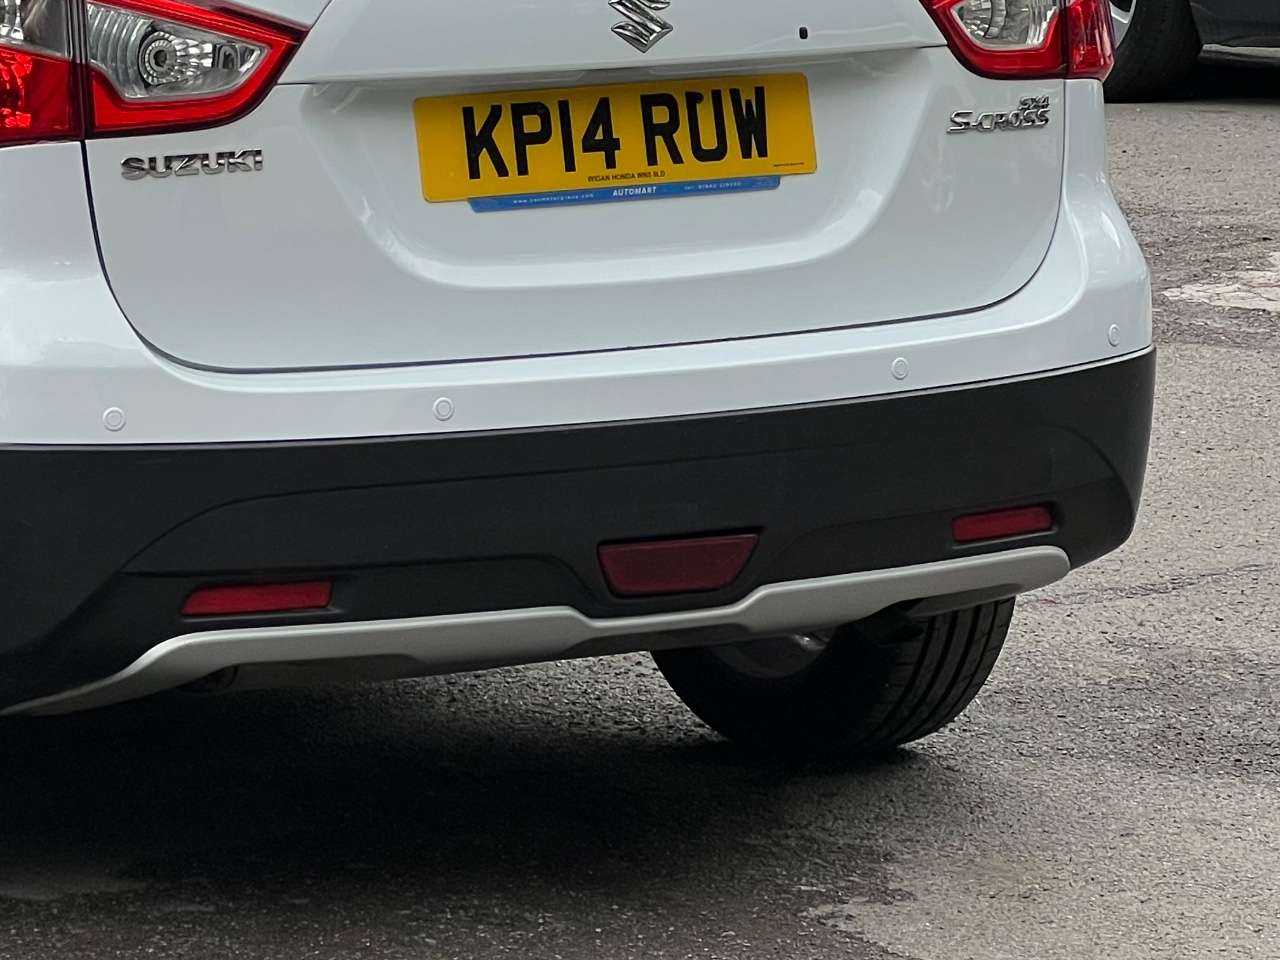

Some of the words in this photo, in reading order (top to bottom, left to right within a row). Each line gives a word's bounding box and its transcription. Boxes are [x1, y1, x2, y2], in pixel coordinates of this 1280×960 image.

[461, 96, 621, 180] KP14
[639, 86, 769, 167] RUW
[120, 149, 263, 181] SUZUKI
[612, 186, 657, 197] AUTOMART
